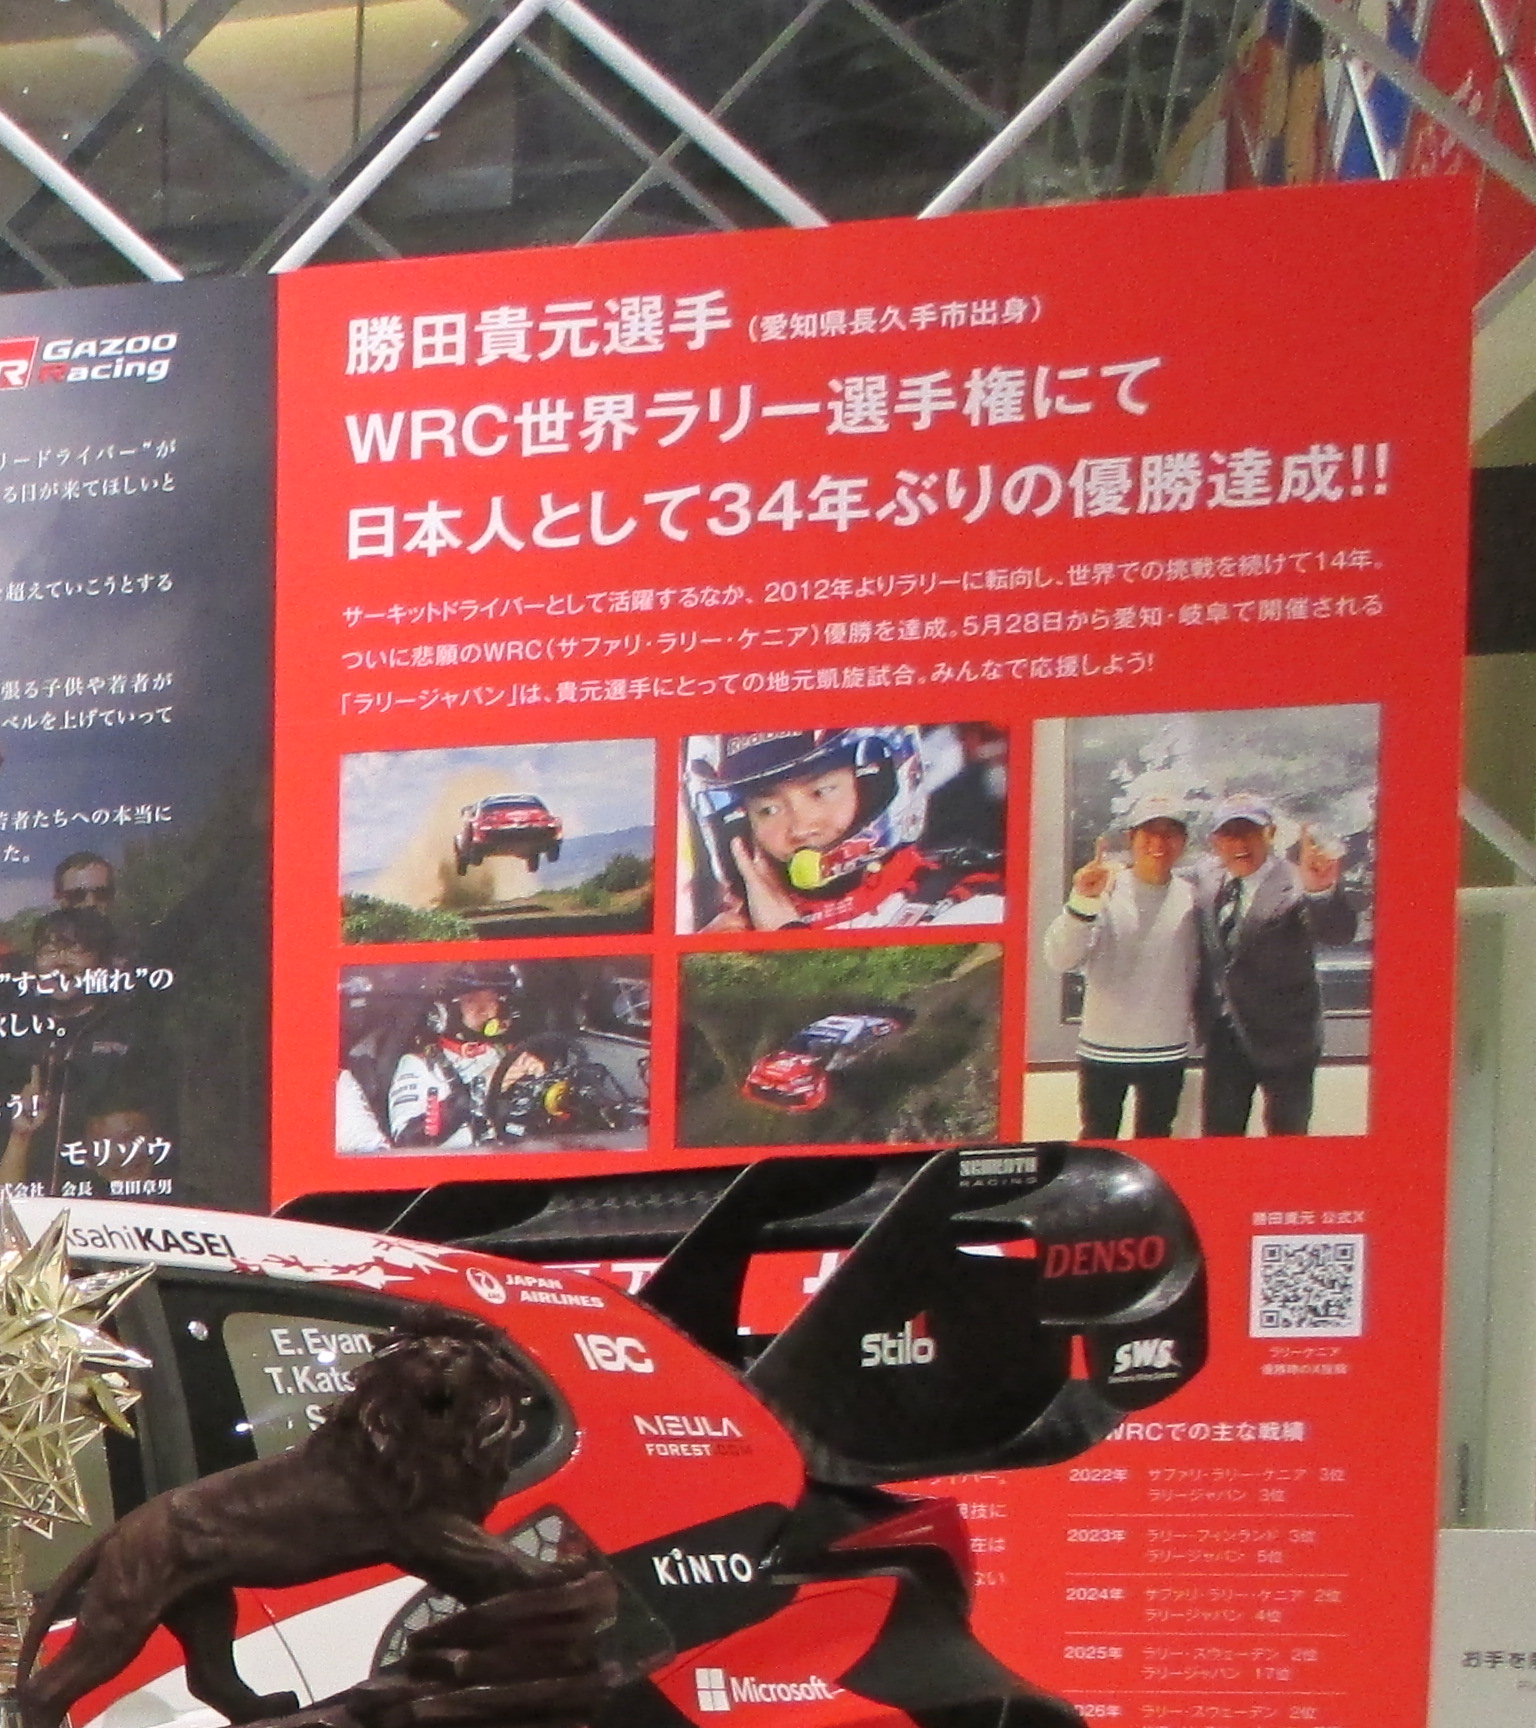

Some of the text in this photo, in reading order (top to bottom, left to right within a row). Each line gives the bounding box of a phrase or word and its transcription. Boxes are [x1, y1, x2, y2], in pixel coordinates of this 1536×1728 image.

[42, 332, 179, 362] GAZOO
[345, 289, 734, 377] 勝田貴元選手
[38, 355, 171, 385] Racing
[345, 355, 1163, 465] WRC世界ラリー選手権にて
[346, 442, 1391, 560] 日本人として34年ぶりの優勝達成!!
[59, 1135, 174, 1168] モリゾウ
[62, 1180, 93, 1197] 会長
[1042, 1235, 1168, 1279] DENSO
[505, 1274, 564, 1291] JAPAN
[520, 1290, 606, 1309] AIRLINES
[270, 1327, 374, 1358] E.Evan
[860, 1320, 936, 1369] Stilo
[263, 1365, 358, 1395] T.Kats
[1069, 1467, 1128, 1482] 2022年
[1065, 1588, 1125, 1602] 2024年
[1063, 1646, 1124, 1660] 2025年
[730, 1675, 834, 1706] Microsoft
[1072, 1704, 1123, 1718] 026年
